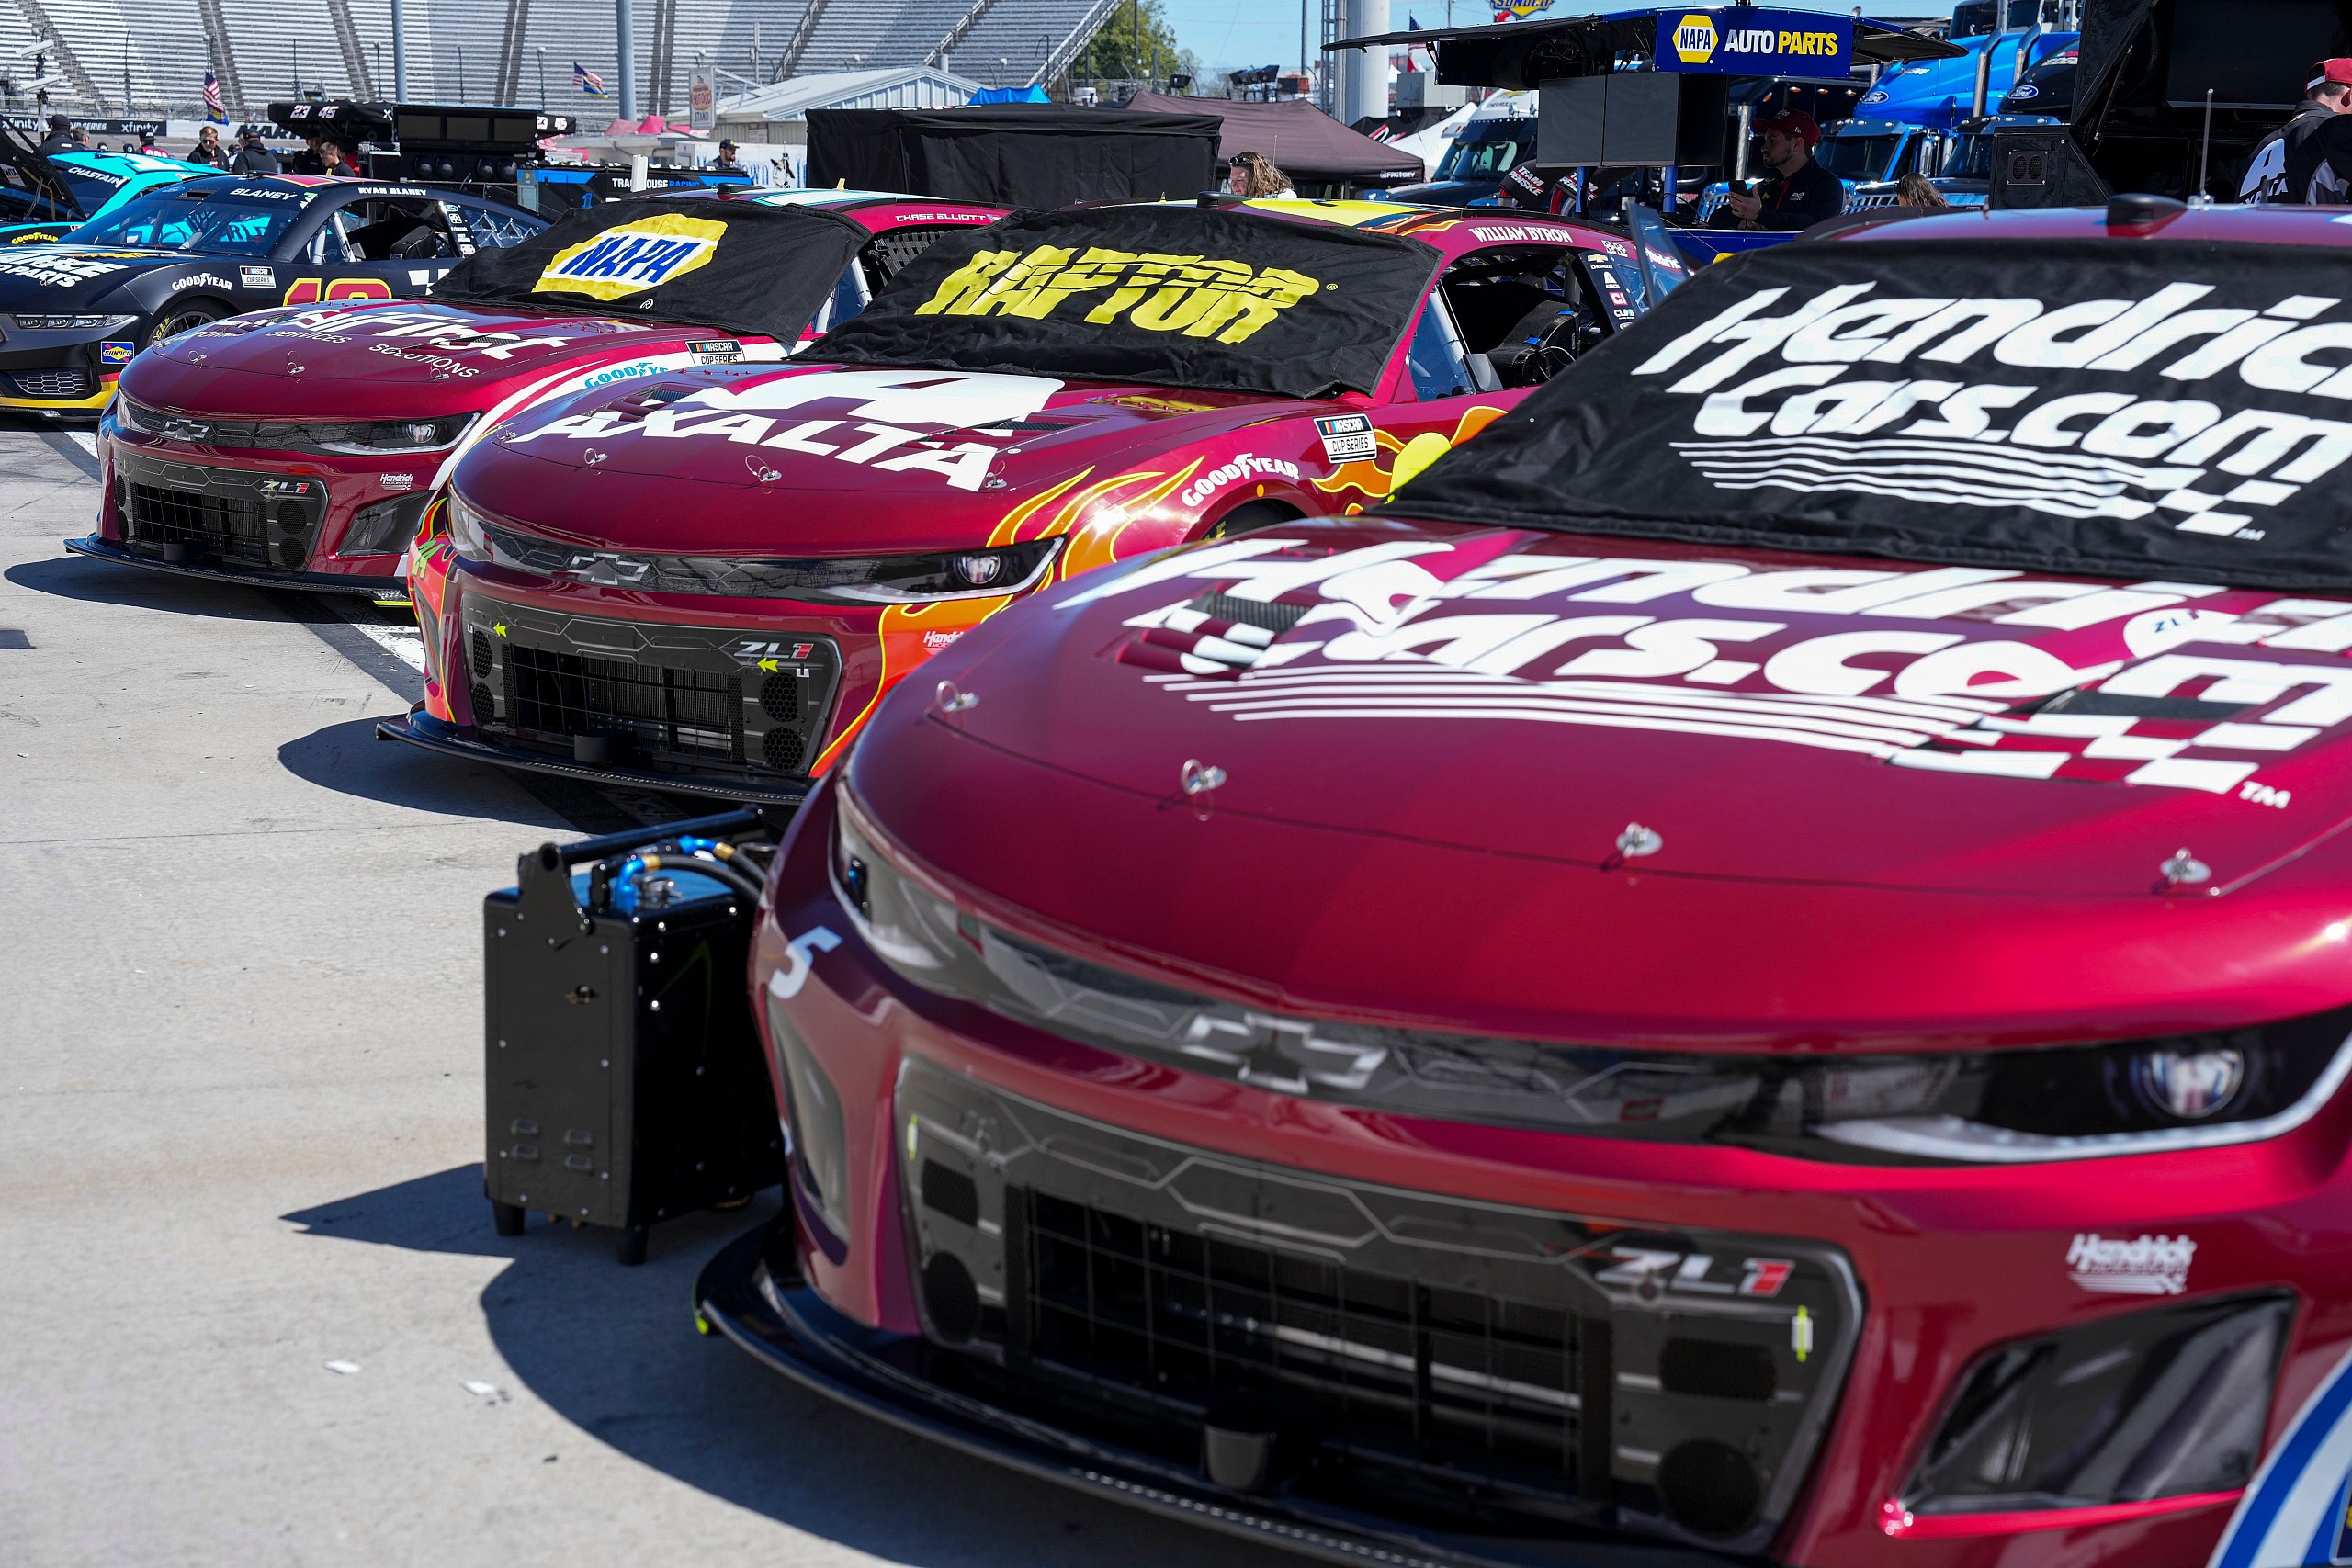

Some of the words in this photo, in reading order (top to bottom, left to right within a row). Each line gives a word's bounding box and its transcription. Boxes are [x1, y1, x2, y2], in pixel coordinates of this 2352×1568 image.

[1680, 28, 1712, 50] NAPA
[1724, 29, 1774, 53] AUTO
[1778, 31, 1838, 56] PARTS
[290, 105, 311, 118] 23
[318, 106, 339, 118] 45
[68, 166, 124, 186] CHASTAIN
[1509, 170, 1543, 196] PENSKE
[1519, 166, 1544, 186] TEAM
[230, 187, 298, 201] BLANEY
[390, 187, 427, 196] BLANEY
[895, 213, 934, 222] CHASE
[936, 213, 985, 221] ELLIOTT
[11, 231, 58, 244] GOODYEAR
[1469, 226, 1522, 243] WILLIAM
[1525, 226, 1573, 243] BYRON
[558, 235, 701, 284] NAPA
[172, 272, 232, 291] GOODYEAR
[249, 267, 268, 276] NASCAR
[914, 245, 1320, 344] RAPTOR
[704, 340, 733, 352] NASCAR
[1631, 282, 2352, 393] Hendric
[104, 348, 132, 358] SUNOCO
[368, 344, 480, 378] SOLUTIONS
[701, 355, 714, 365] CUP
[715, 355, 738, 365] SERIES
[1331, 417, 1364, 433] NASCAR
[507, 407, 999, 492] AXALTA
[1331, 440, 1345, 453] CUP
[1346, 437, 1369, 451] SERIES
[262, 479, 311, 494] ZL1
[379, 474, 413, 484] Hendrick
[1181, 453, 1300, 507] GOODYEAR
[733, 640, 815, 660] ZL1
[2238, 782, 2291, 808] TM
[768, 924, 843, 1000] 5
[2065, 1233, 2198, 1273] Hendrick
[1594, 1246, 1797, 1298] ZL1
